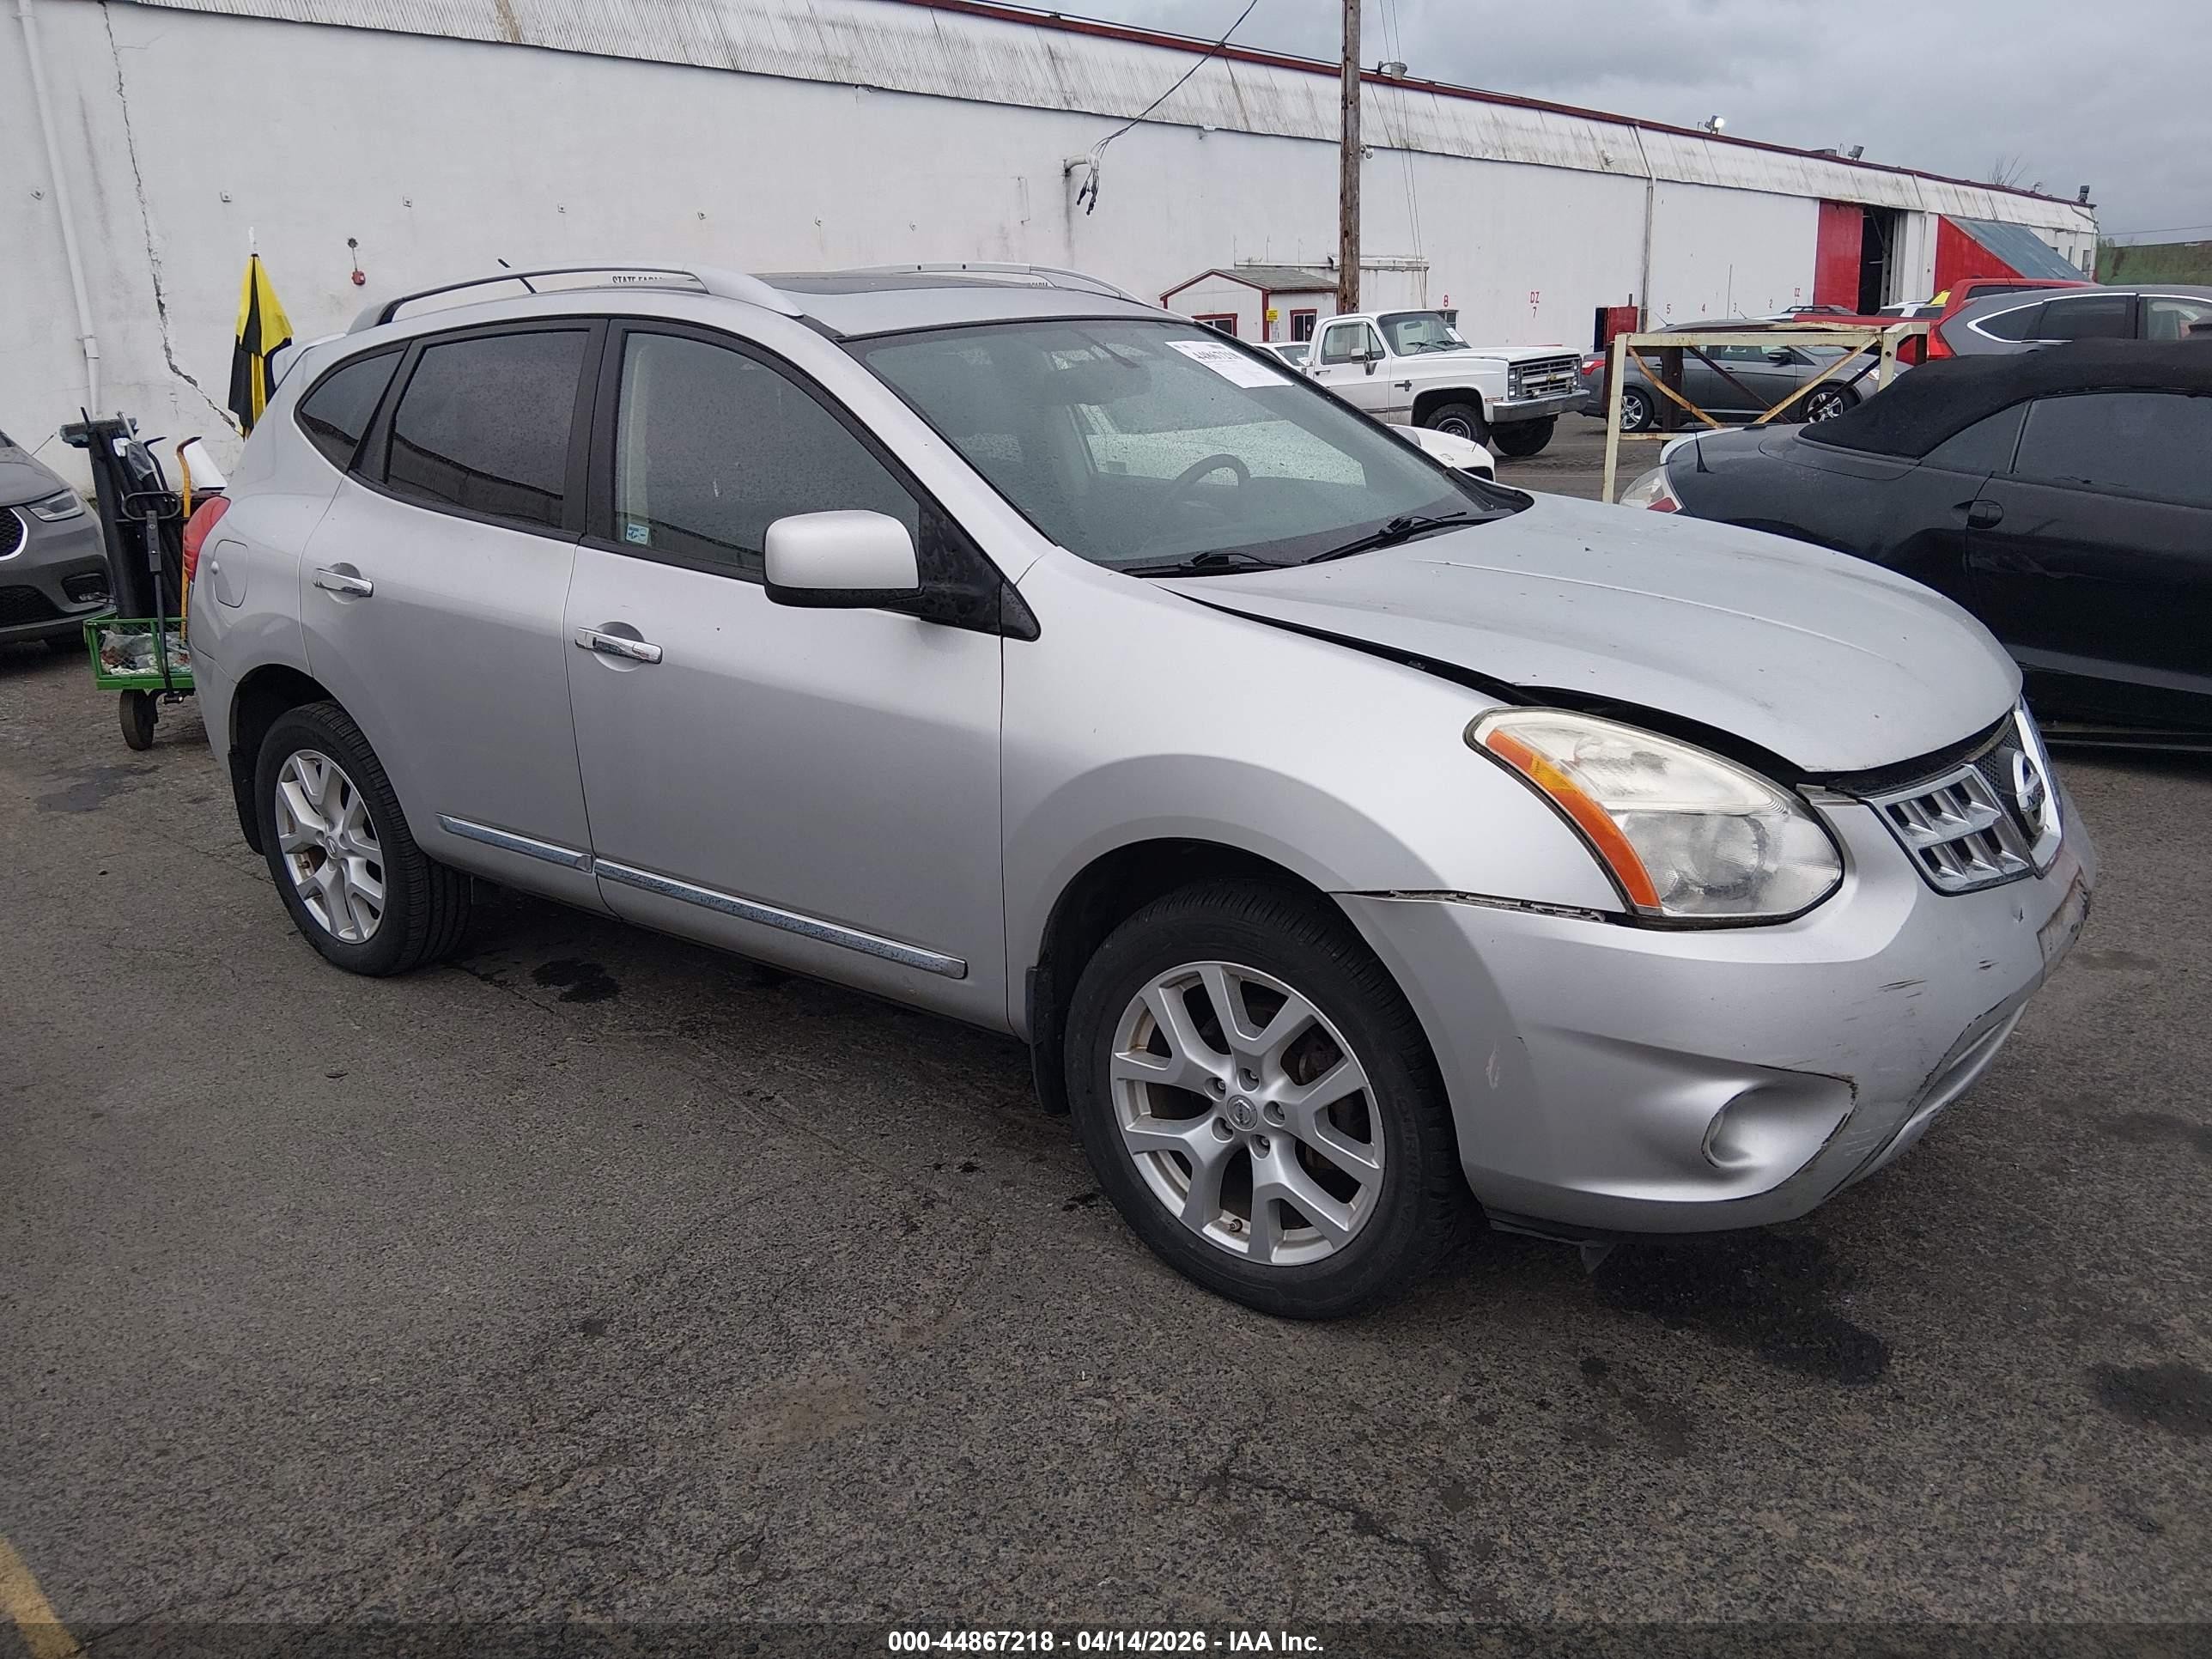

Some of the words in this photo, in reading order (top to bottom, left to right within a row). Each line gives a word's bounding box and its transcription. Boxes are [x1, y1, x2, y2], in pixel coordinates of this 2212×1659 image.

[1443, 295, 1449, 307] 8
[1529, 291, 1540, 303] DZ
[1666, 304, 1671, 314] 5
[1701, 303, 1706, 313] 4
[1769, 299, 1773, 309] 2
[1532, 307, 1537, 319] 7
